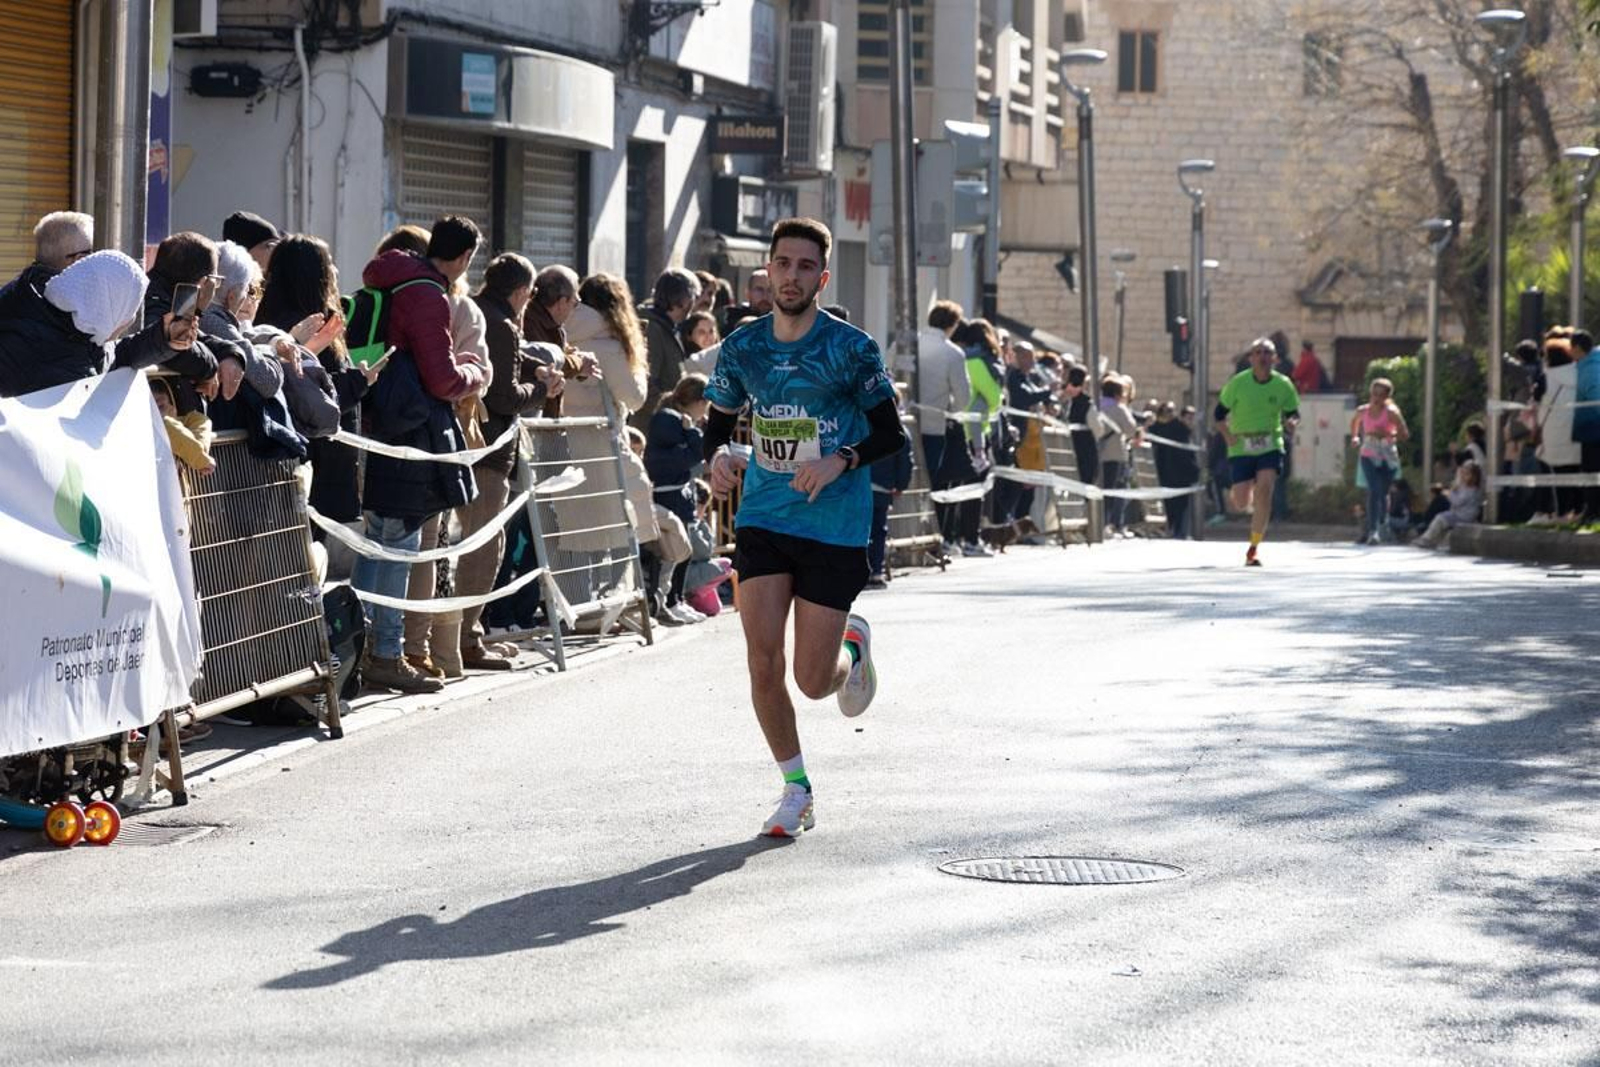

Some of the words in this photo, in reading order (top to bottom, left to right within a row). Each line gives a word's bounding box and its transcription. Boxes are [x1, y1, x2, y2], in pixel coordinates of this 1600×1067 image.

[761, 404, 809, 418] MEDIA
[761, 438, 800, 461] 407
[40, 632, 94, 658] Patronato
[107, 656, 120, 673] de
